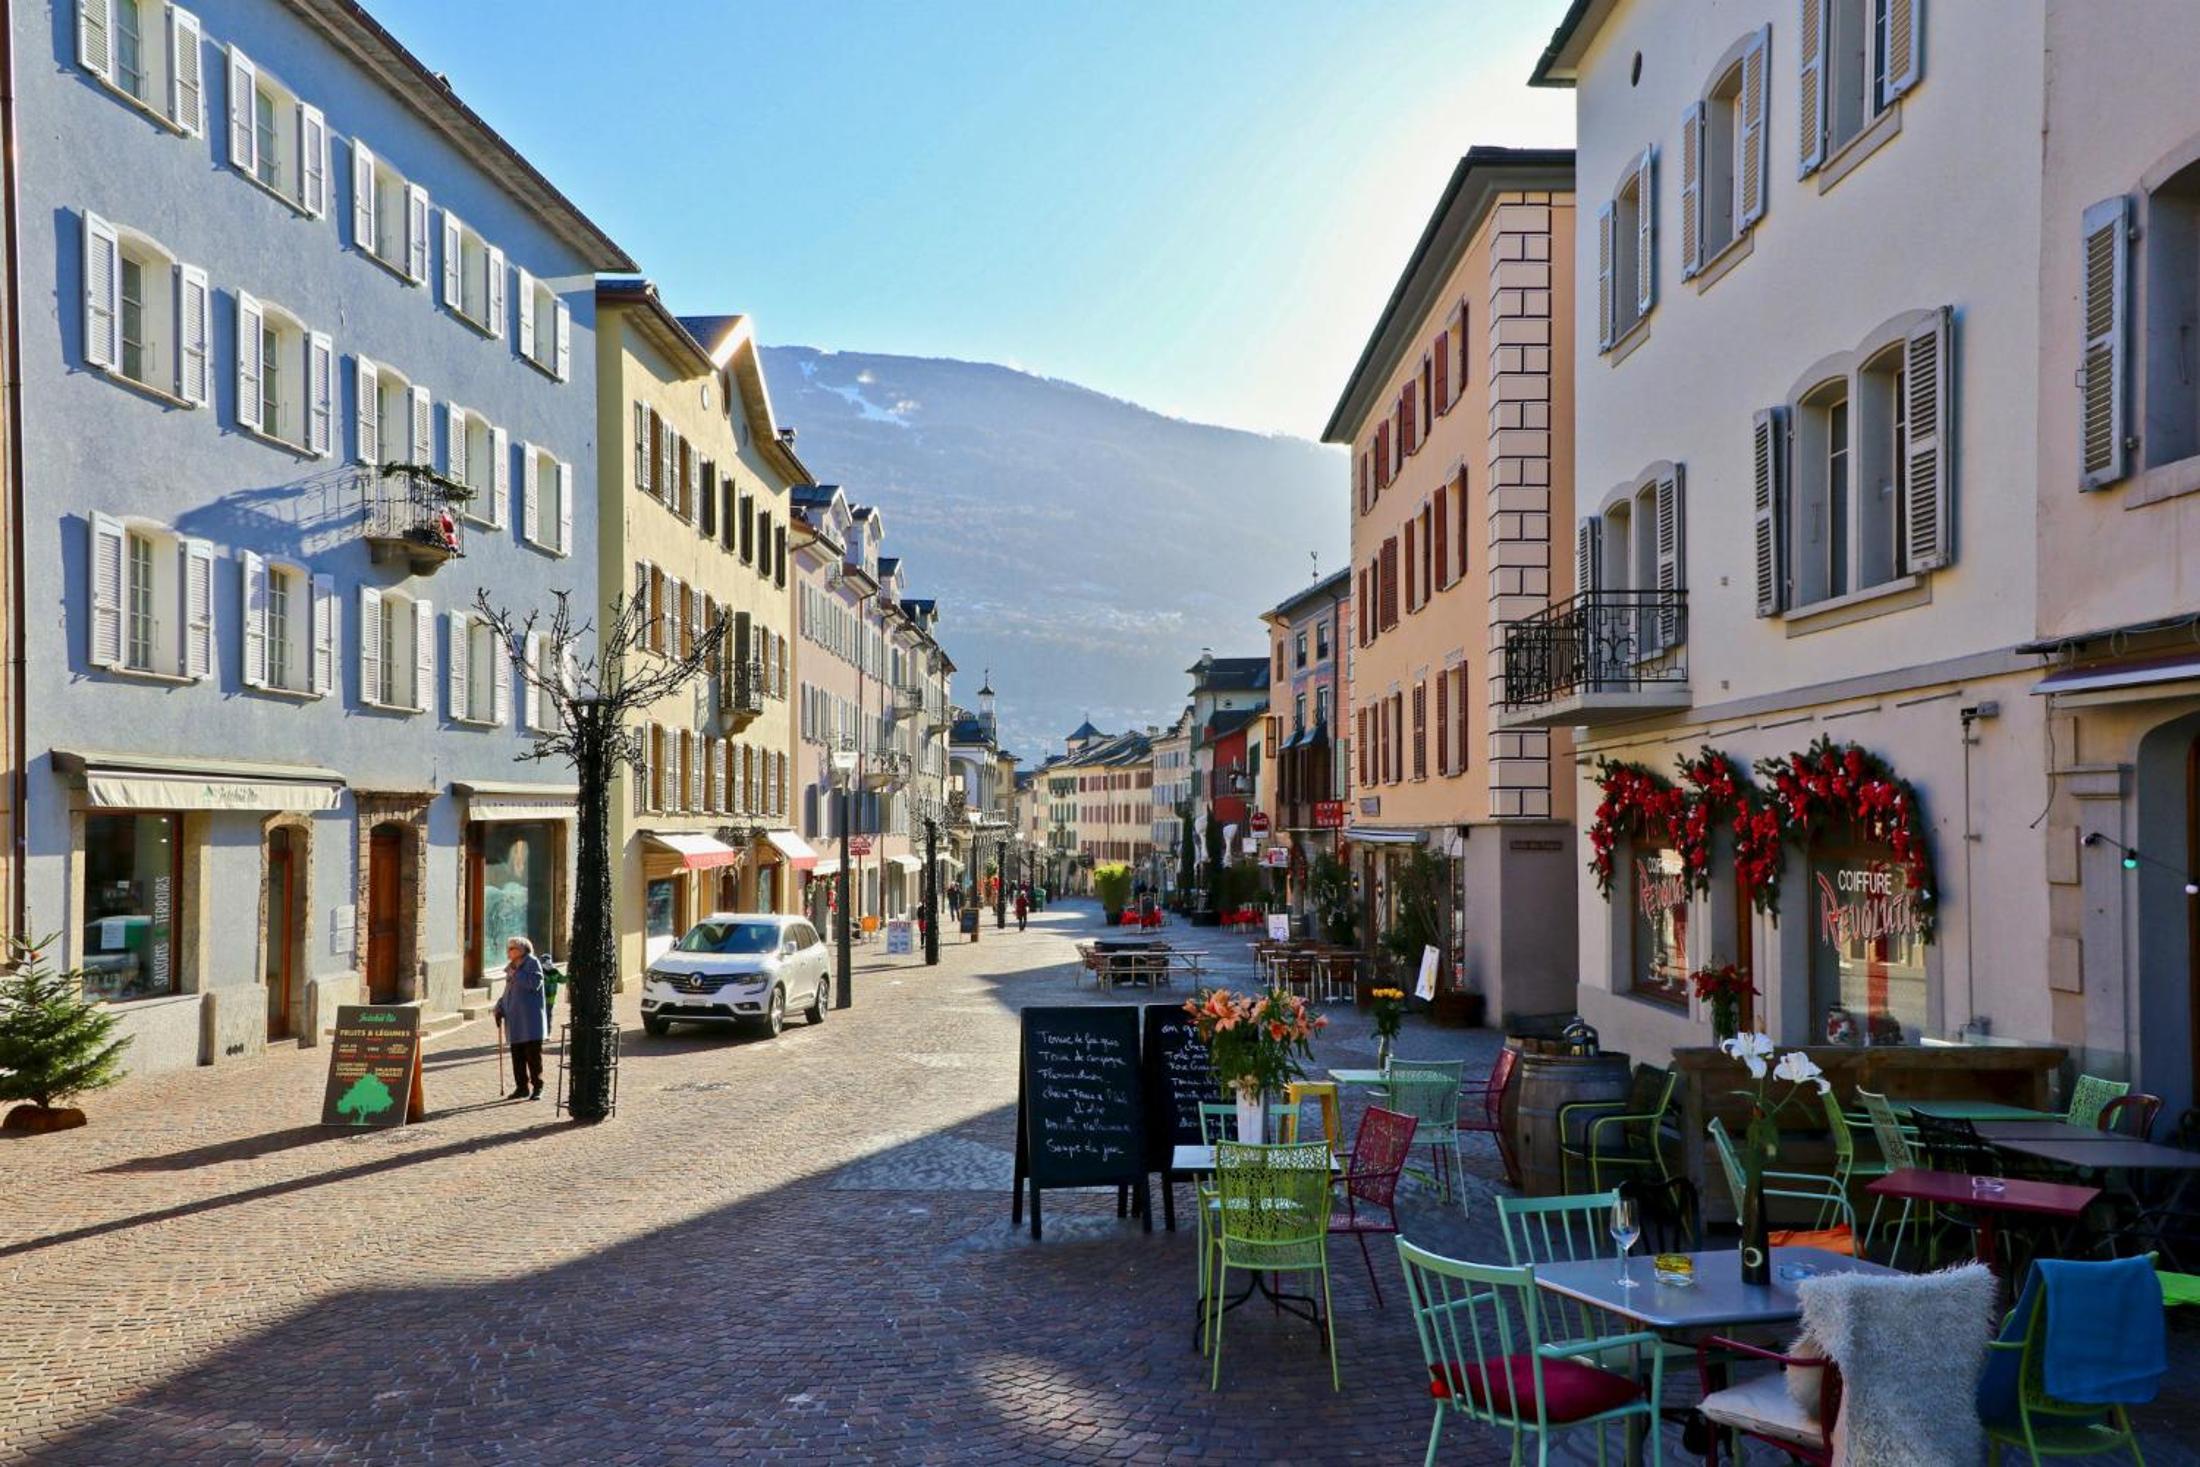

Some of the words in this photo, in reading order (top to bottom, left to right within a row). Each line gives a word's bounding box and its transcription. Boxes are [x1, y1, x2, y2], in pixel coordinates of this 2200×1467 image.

[155, 876, 171, 926] TERROIRS
[1838, 869, 1892, 895] COIFFURE
[153, 941, 169, 986] SAISONS
